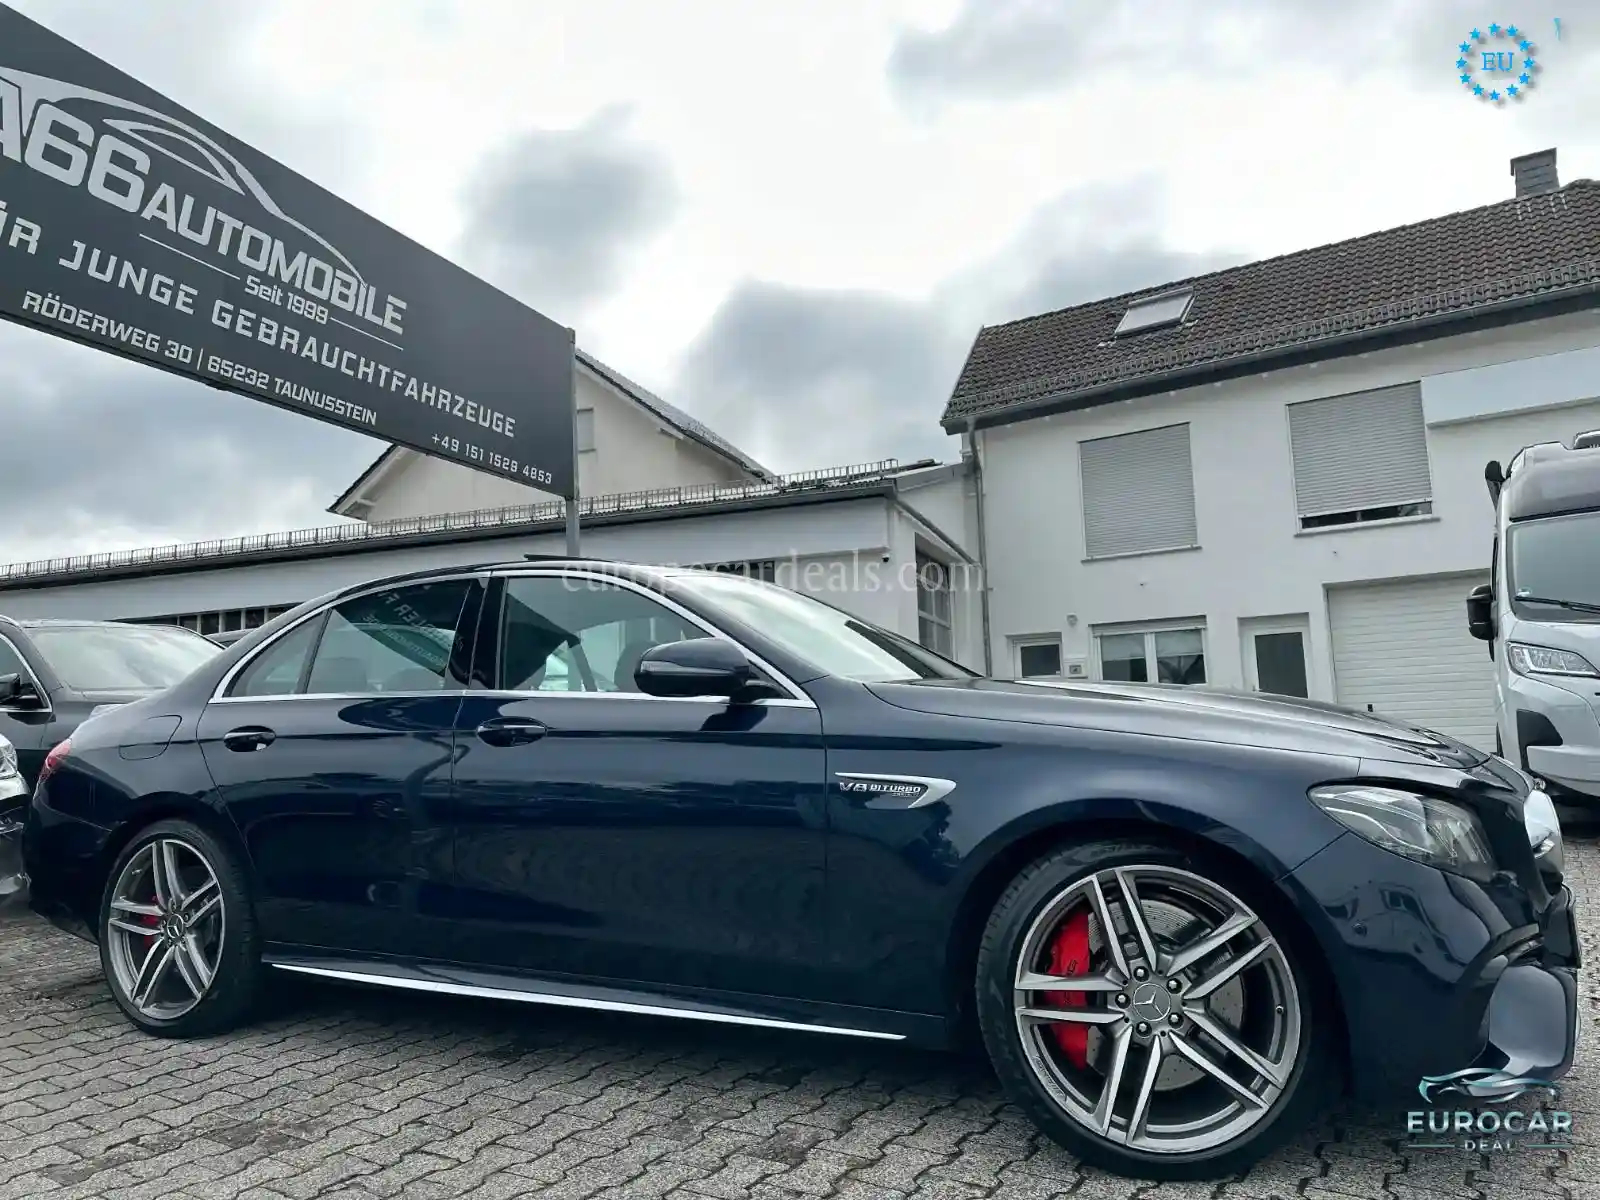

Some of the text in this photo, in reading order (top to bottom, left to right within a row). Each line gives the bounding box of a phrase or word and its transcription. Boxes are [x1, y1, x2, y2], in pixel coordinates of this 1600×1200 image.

[244, 274, 329, 325] Seit 1999
[22, 290, 377, 427] RÖDERWEG 30 65232 TAUNUSSTEIN
[58, 240, 199, 315] JUNGE
[211, 299, 516, 438] GEBRAUCHTFAHRZEUGE
[431, 433, 460, 453] +49
[465, 443, 484, 461] 151
[522, 464, 552, 485] 4853
[839, 782, 921, 793] V8 BITURBO
